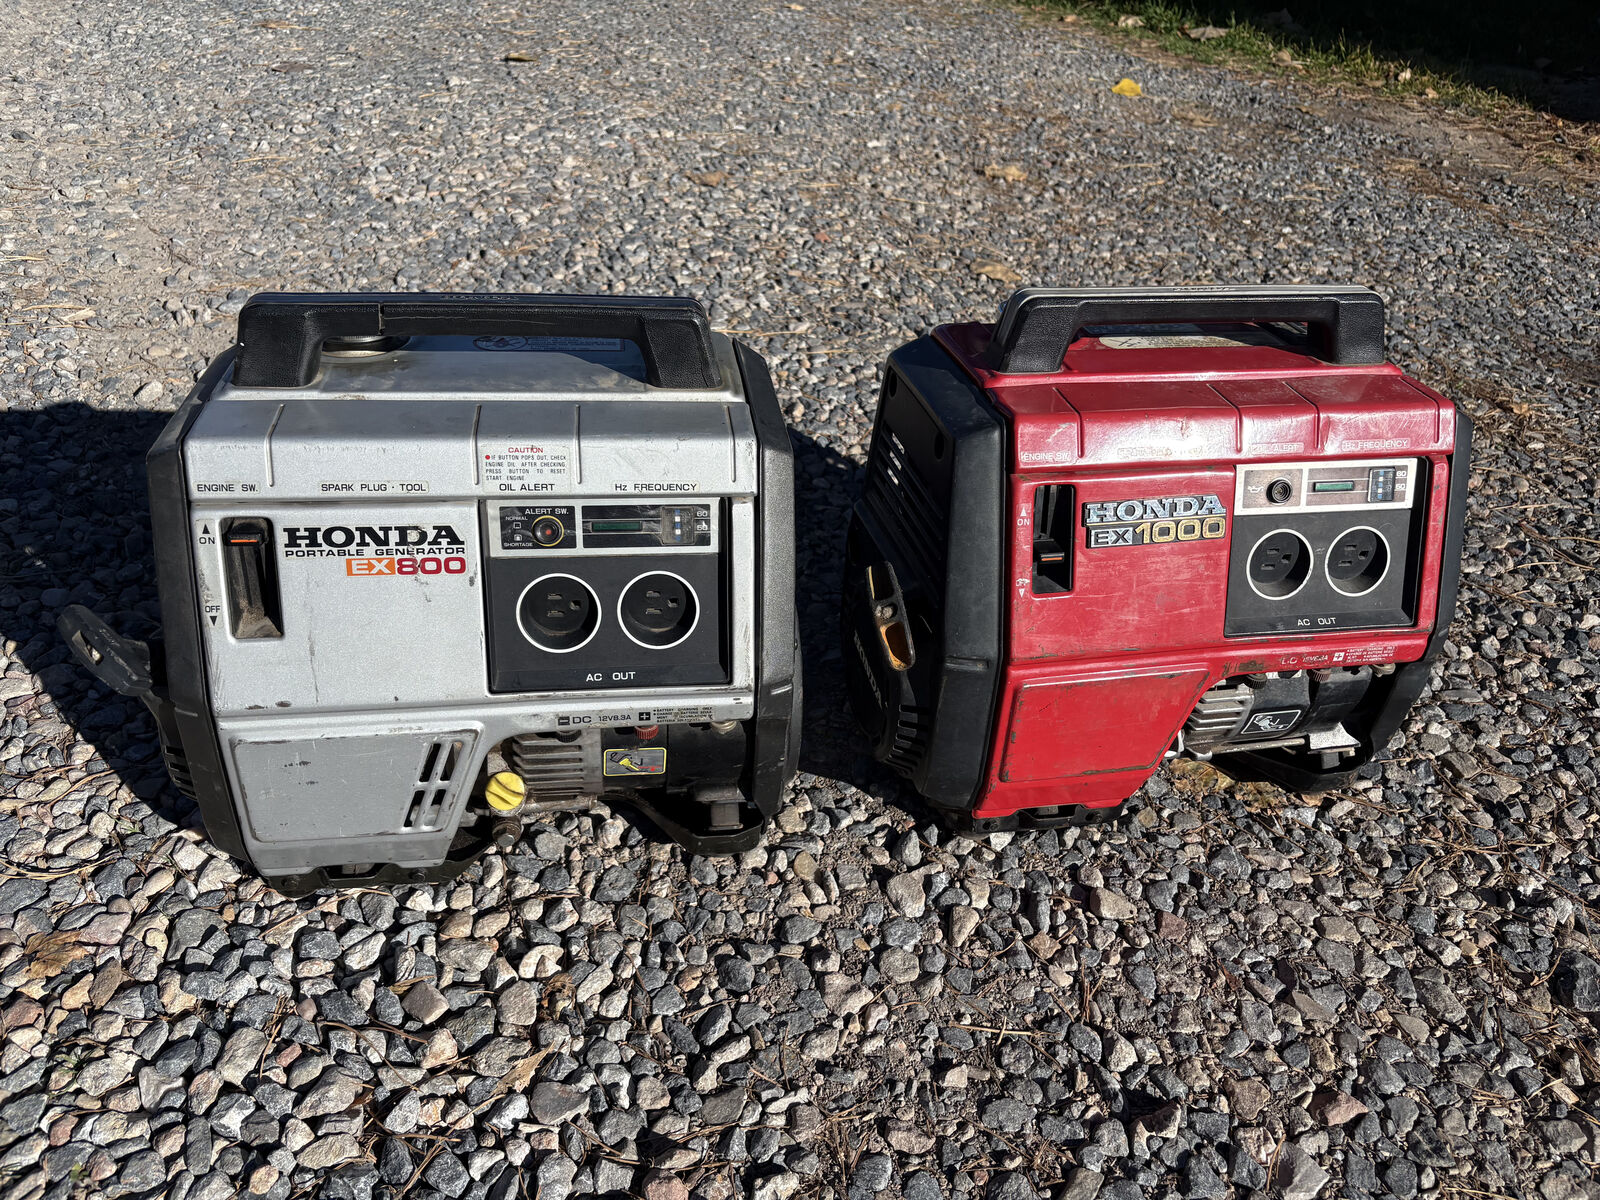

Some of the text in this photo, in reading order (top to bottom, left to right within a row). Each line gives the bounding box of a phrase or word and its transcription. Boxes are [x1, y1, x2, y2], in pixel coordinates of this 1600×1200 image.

[1358, 440, 1408, 449] FREQUENCY
[197, 484, 258, 492] ENGINE SW.
[321, 484, 426, 492] SPARK PLUG TOOL
[1086, 495, 1226, 523] HONDA
[283, 526, 465, 548] HONDA
[1090, 517, 1226, 548] EX1000
[286, 548, 465, 558] PORTABLE GENERATOR
[346, 557, 466, 576] EX800
[586, 672, 636, 682] AC OUT
[572, 716, 592, 724] DC
